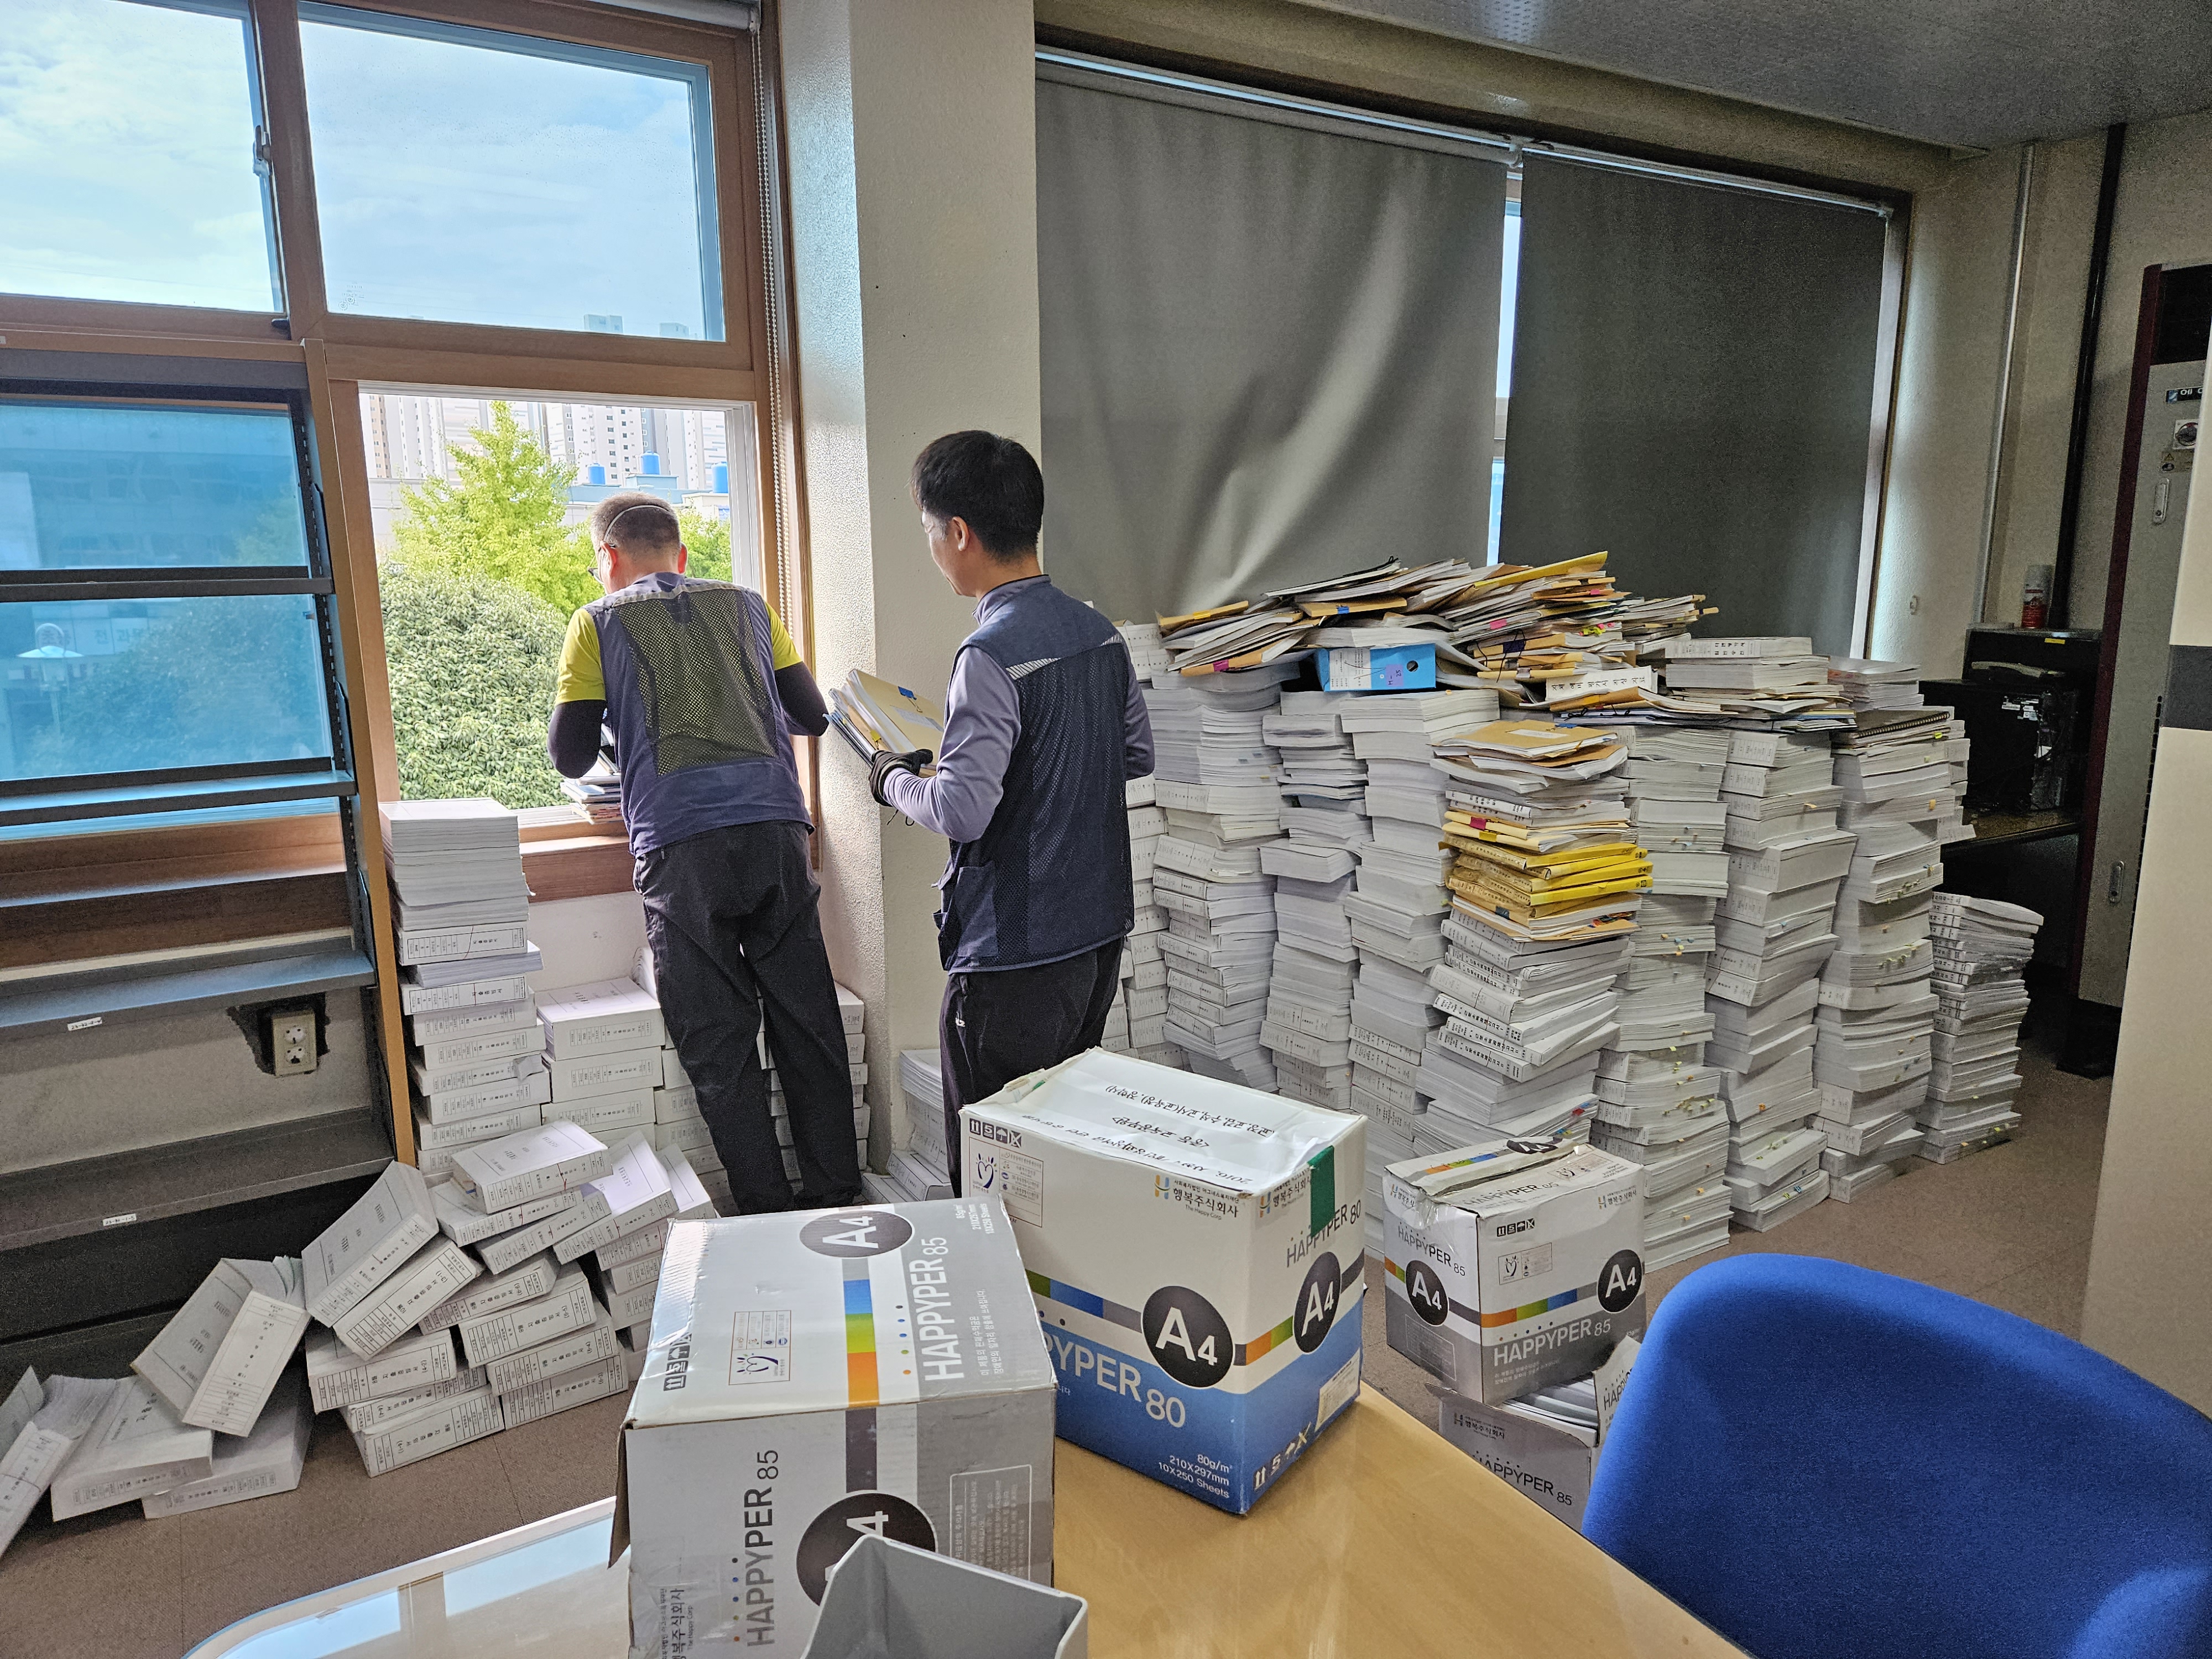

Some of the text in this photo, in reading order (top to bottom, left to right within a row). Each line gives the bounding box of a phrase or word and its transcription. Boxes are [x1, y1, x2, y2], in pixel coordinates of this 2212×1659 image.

[1174, 1180, 1201, 1192] 사회복지법인
[1215, 1170, 1253, 1184] 2016.
[980, 1203, 994, 1234] 10X250 Sheets
[1173, 1188, 1239, 1218] 행복주식회사
[1194, 1207, 1209, 1216] Happy
[1350, 1200, 1361, 1224] 80
[823, 1215, 880, 1249] A4
[1398, 1225, 1465, 1276] HAPPYPER 85
[1411, 1270, 1442, 1311] A4
[1605, 1263, 1637, 1298] A4
[910, 1237, 965, 1382] HAPPYPER 85
[1301, 1281, 1335, 1338] A4
[969, 1316, 984, 1348] 판매수익금은
[976, 1289, 1004, 1374] 장애인의 일자리 창출에 쓰여집니다.
[1155, 1306, 1218, 1368] A4
[1494, 1319, 1611, 1366] HAPPYPER 85
[977, 1349, 988, 1367] 제품의
[1145, 1388, 1186, 1428] 80
[1159, 1462, 1229, 1499] 10X250 Sheets
[1169, 1455, 1229, 1486] 210X297mm
[1479, 1458, 1572, 1505] APPYPER 85
[743, 1449, 779, 1647] HAPPYPER 85
